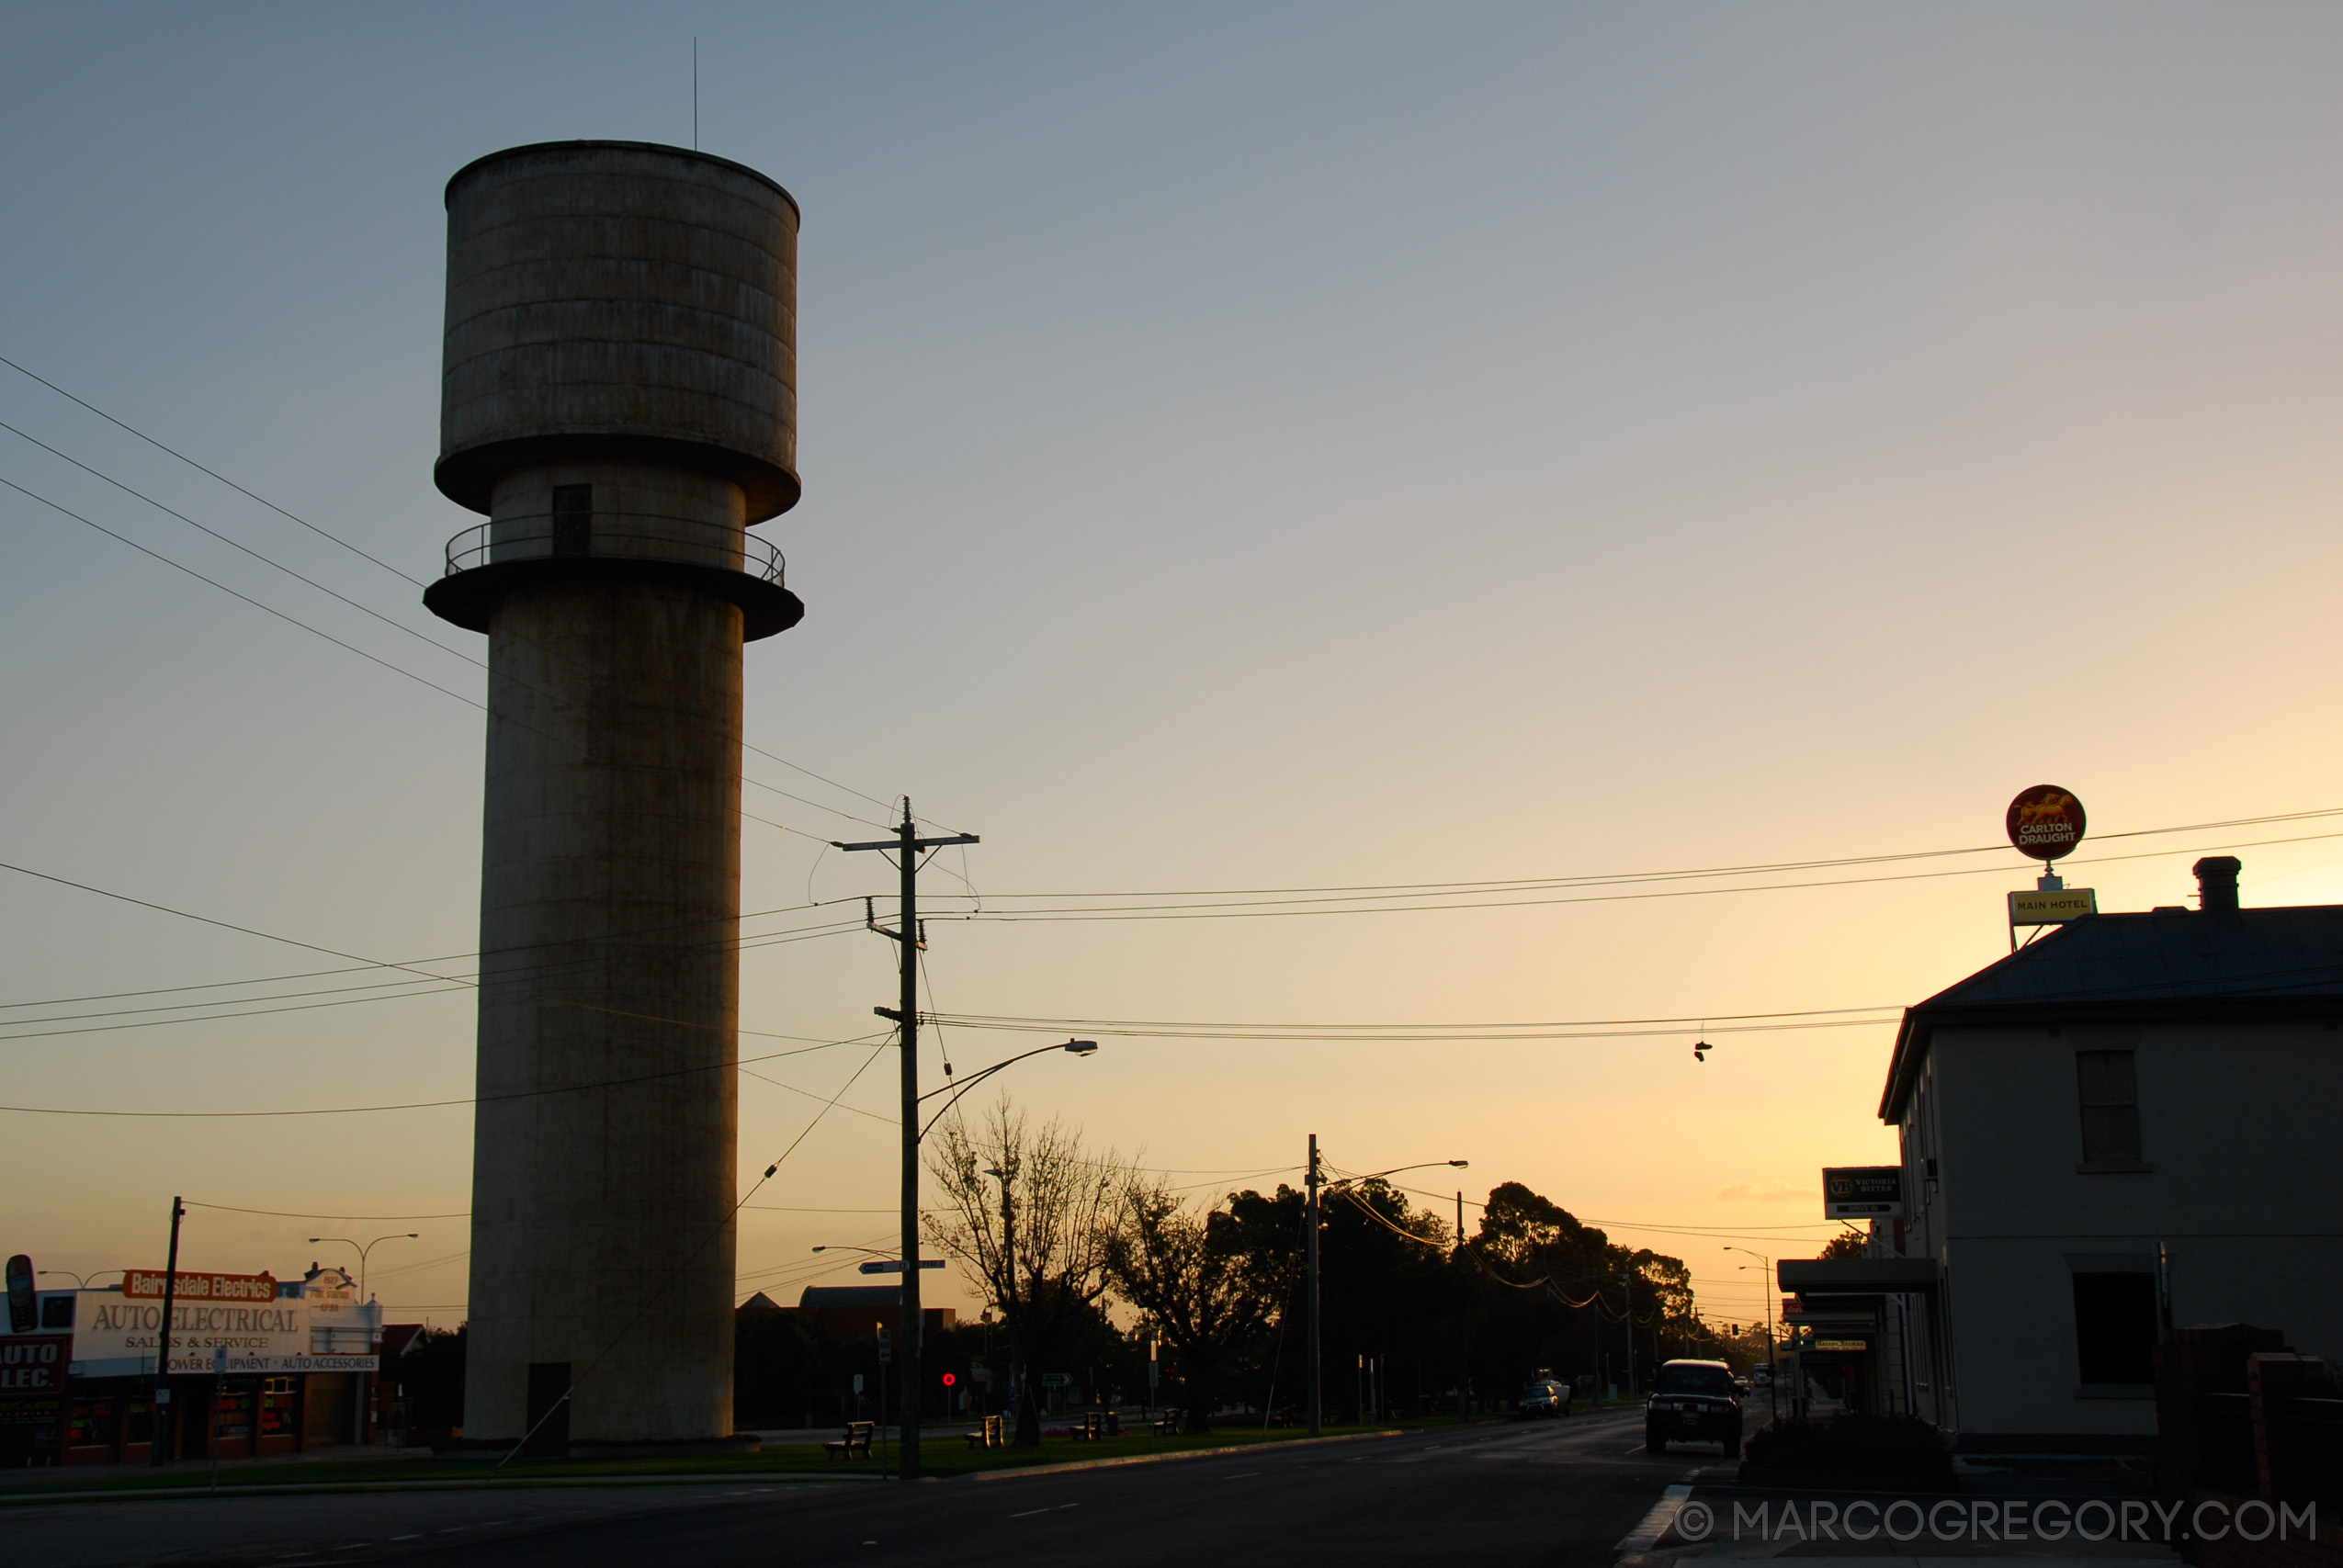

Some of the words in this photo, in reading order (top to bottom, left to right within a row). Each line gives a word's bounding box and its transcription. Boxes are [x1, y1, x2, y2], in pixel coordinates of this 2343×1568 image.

[2020, 822, 2073, 835] CARLTON
[2019, 831, 2077, 845] DRAUGHT
[2018, 901, 2046, 910] MAIN
[2050, 899, 2088, 909] HOTEL
[1831, 1179, 1852, 1193] VB
[1855, 1178, 1897, 1186] VICTORIA
[211, 1276, 272, 1299] Electrics
[92, 1304, 161, 1331] AUTO
[170, 1306, 299, 1332] ELECTRICAL
[187, 1337, 200, 1348] &
[204, 1337, 268, 1348] SERVICE
[0, 1343, 58, 1365] UTO
[168, 1358, 203, 1371] OWER
[206, 1358, 270, 1370] EIPMENT
[281, 1358, 311, 1369] AUTO
[312, 1358, 376, 1369] ACCESSORIES
[0, 1368, 54, 1389] LEC.
